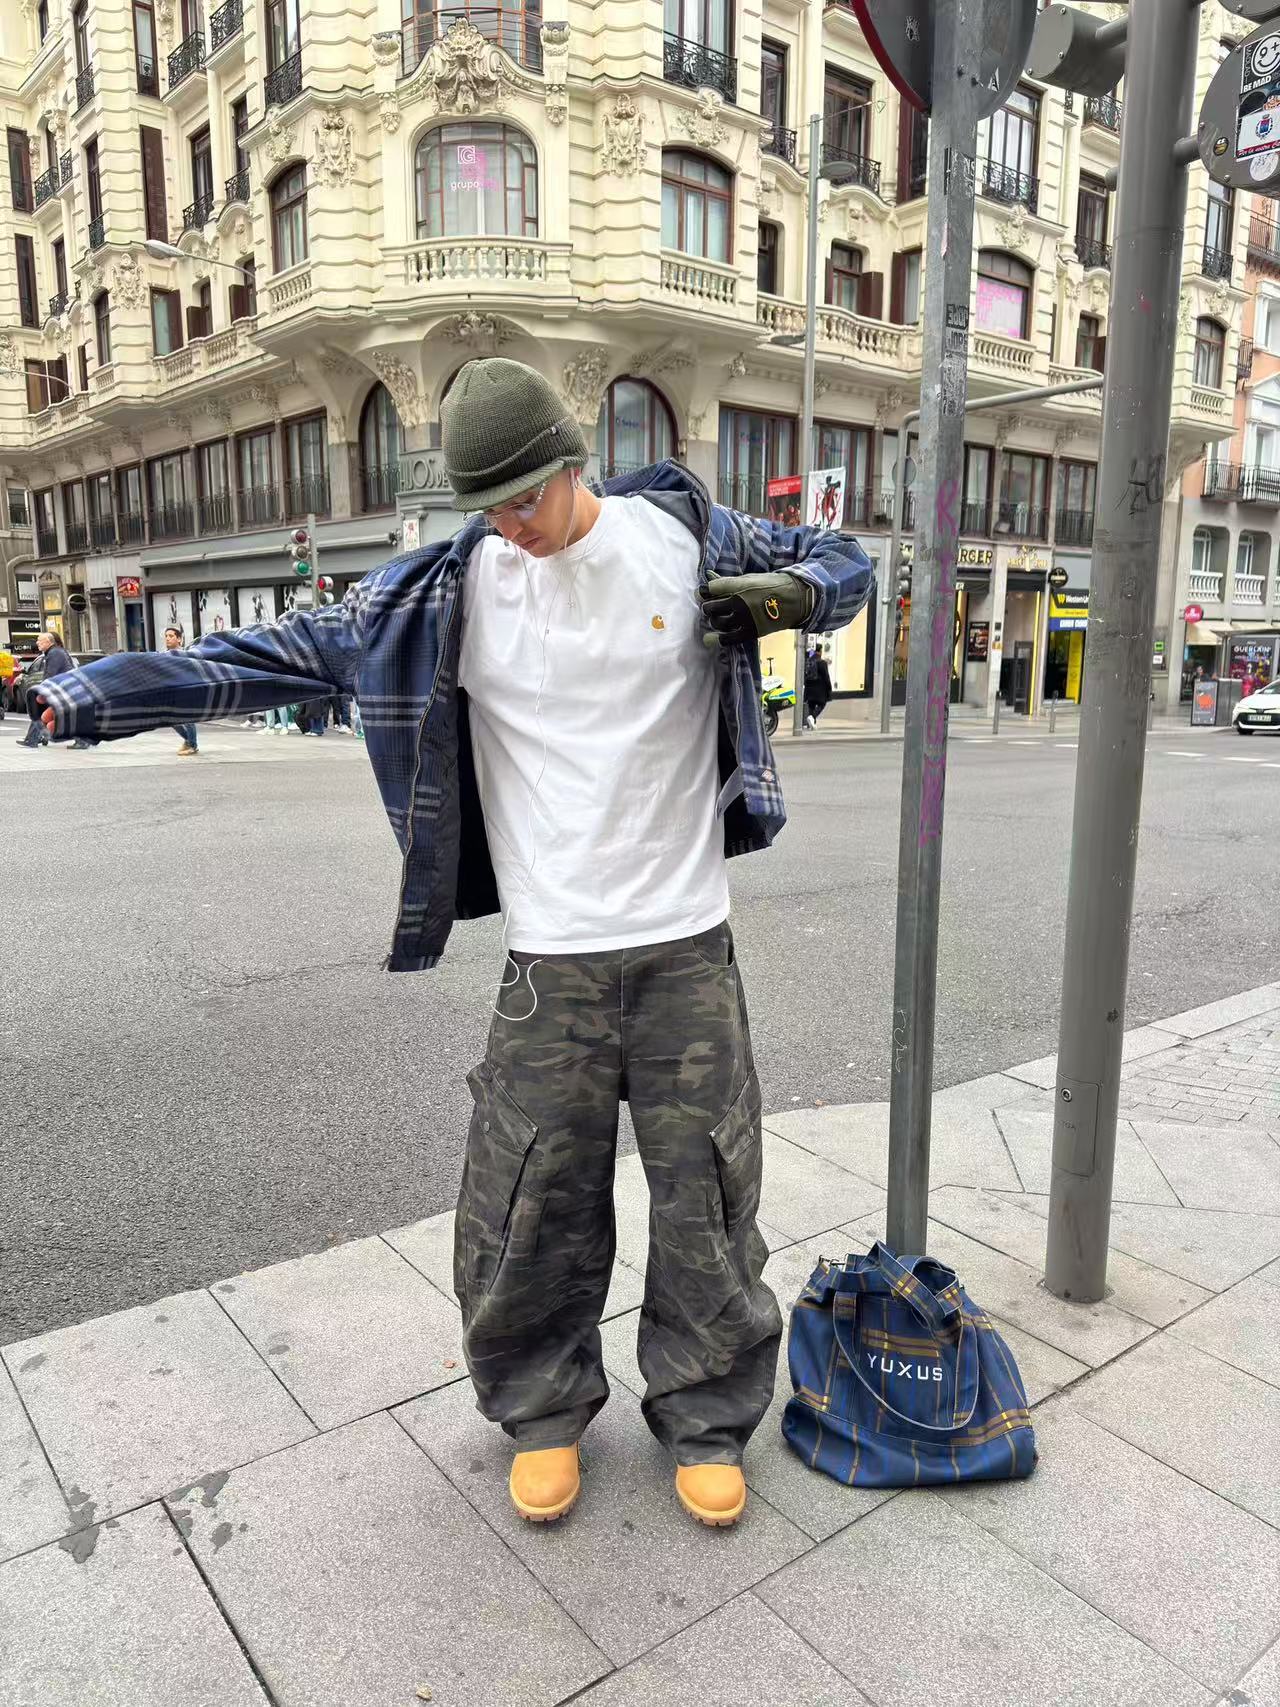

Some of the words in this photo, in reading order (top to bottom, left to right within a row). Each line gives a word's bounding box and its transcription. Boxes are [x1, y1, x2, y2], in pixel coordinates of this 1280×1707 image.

[1243, 82, 1252, 93] BE
[1252, 75, 1272, 89] MAD
[450, 181, 480, 192] grupo
[958, 549, 993, 565] RGER
[867, 1353, 943, 1382] YUXUS
